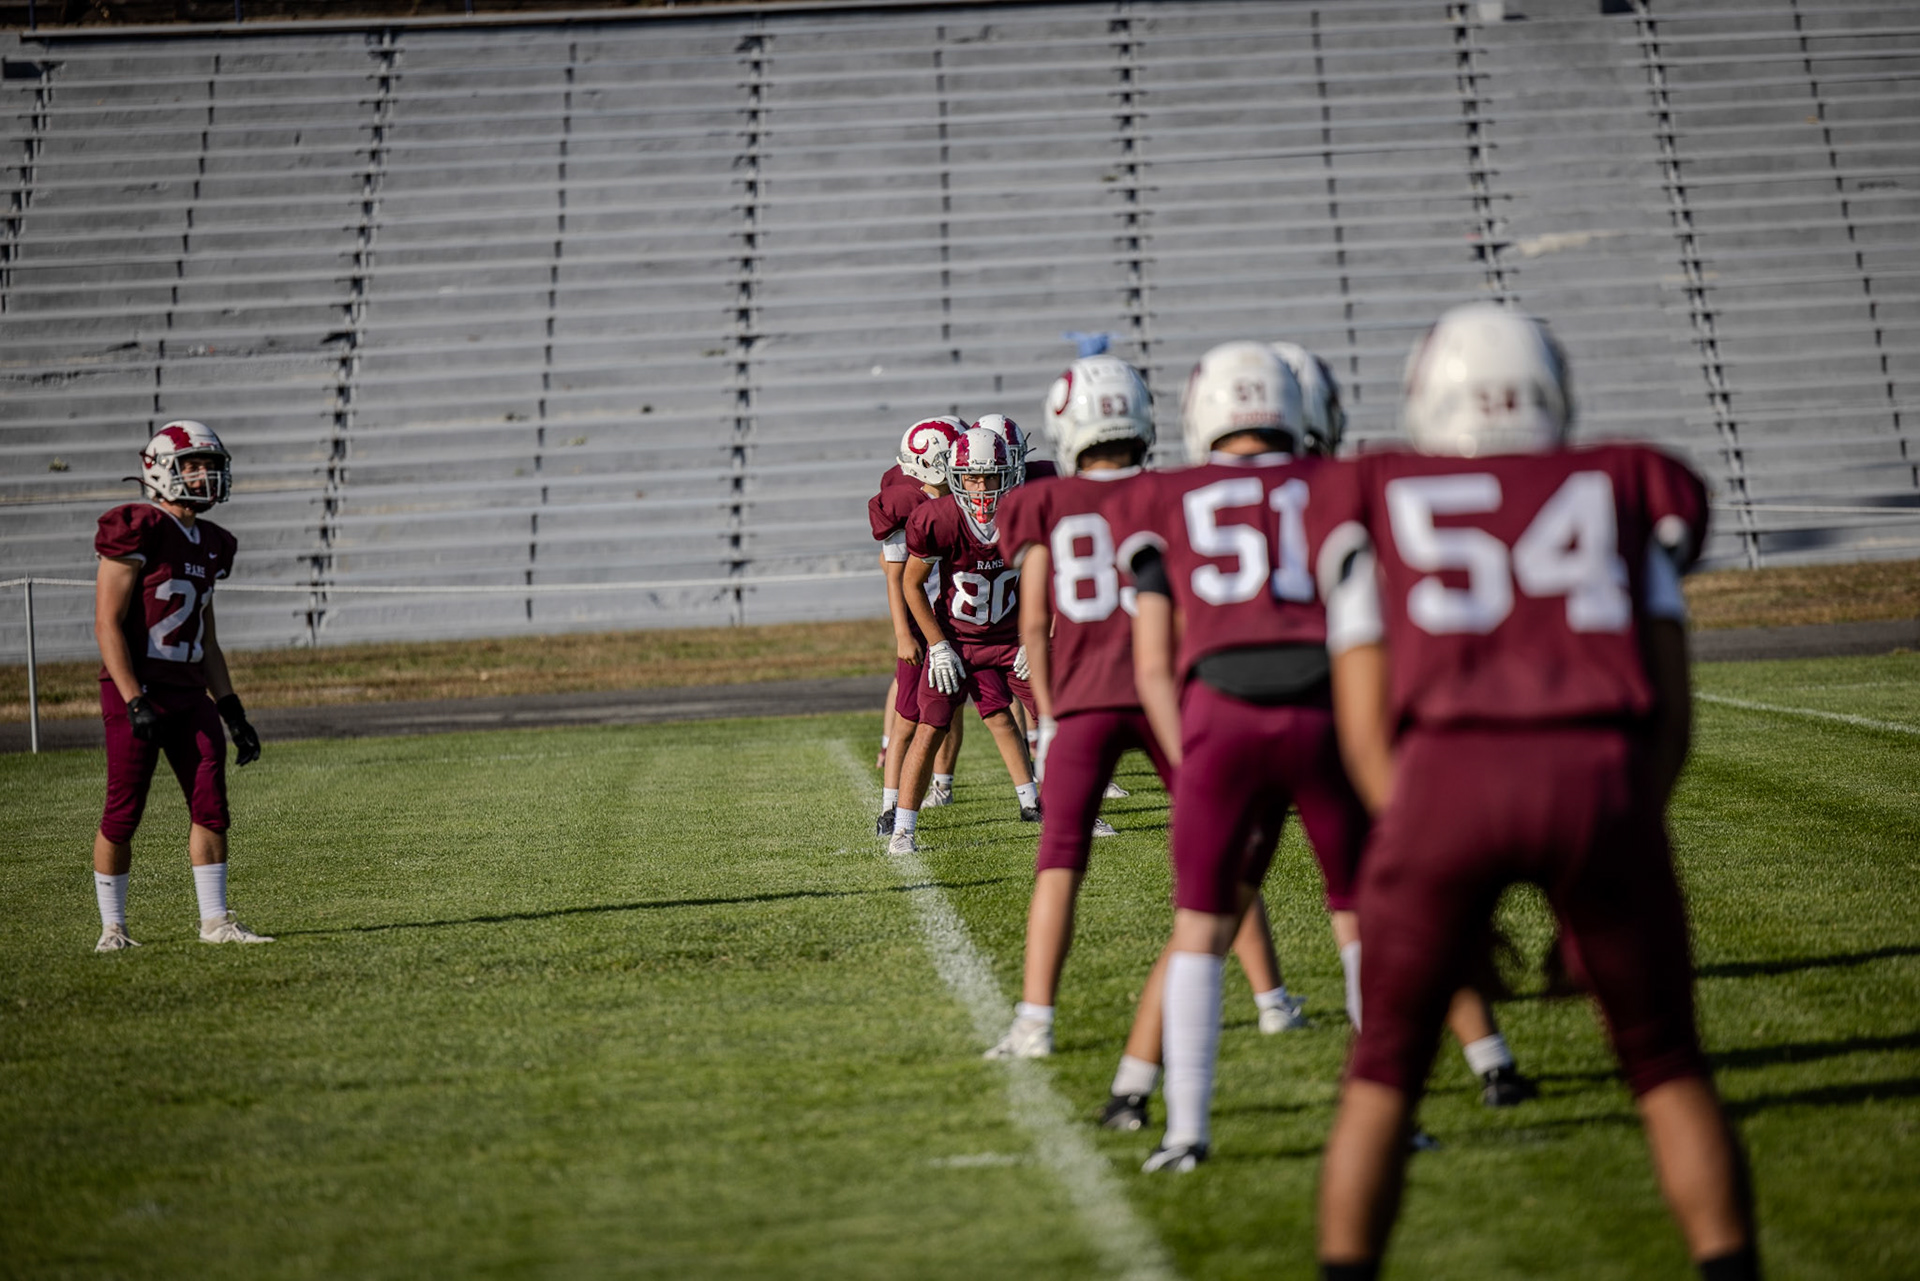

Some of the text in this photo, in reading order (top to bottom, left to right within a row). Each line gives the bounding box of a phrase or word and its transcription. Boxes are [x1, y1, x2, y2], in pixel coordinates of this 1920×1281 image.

[1100, 394, 1129, 416] 83
[976, 559, 1004, 570] RAMS
[1183, 477, 1314, 605] 51
[1385, 471, 1633, 635] 54
[951, 570, 1021, 626] 80
